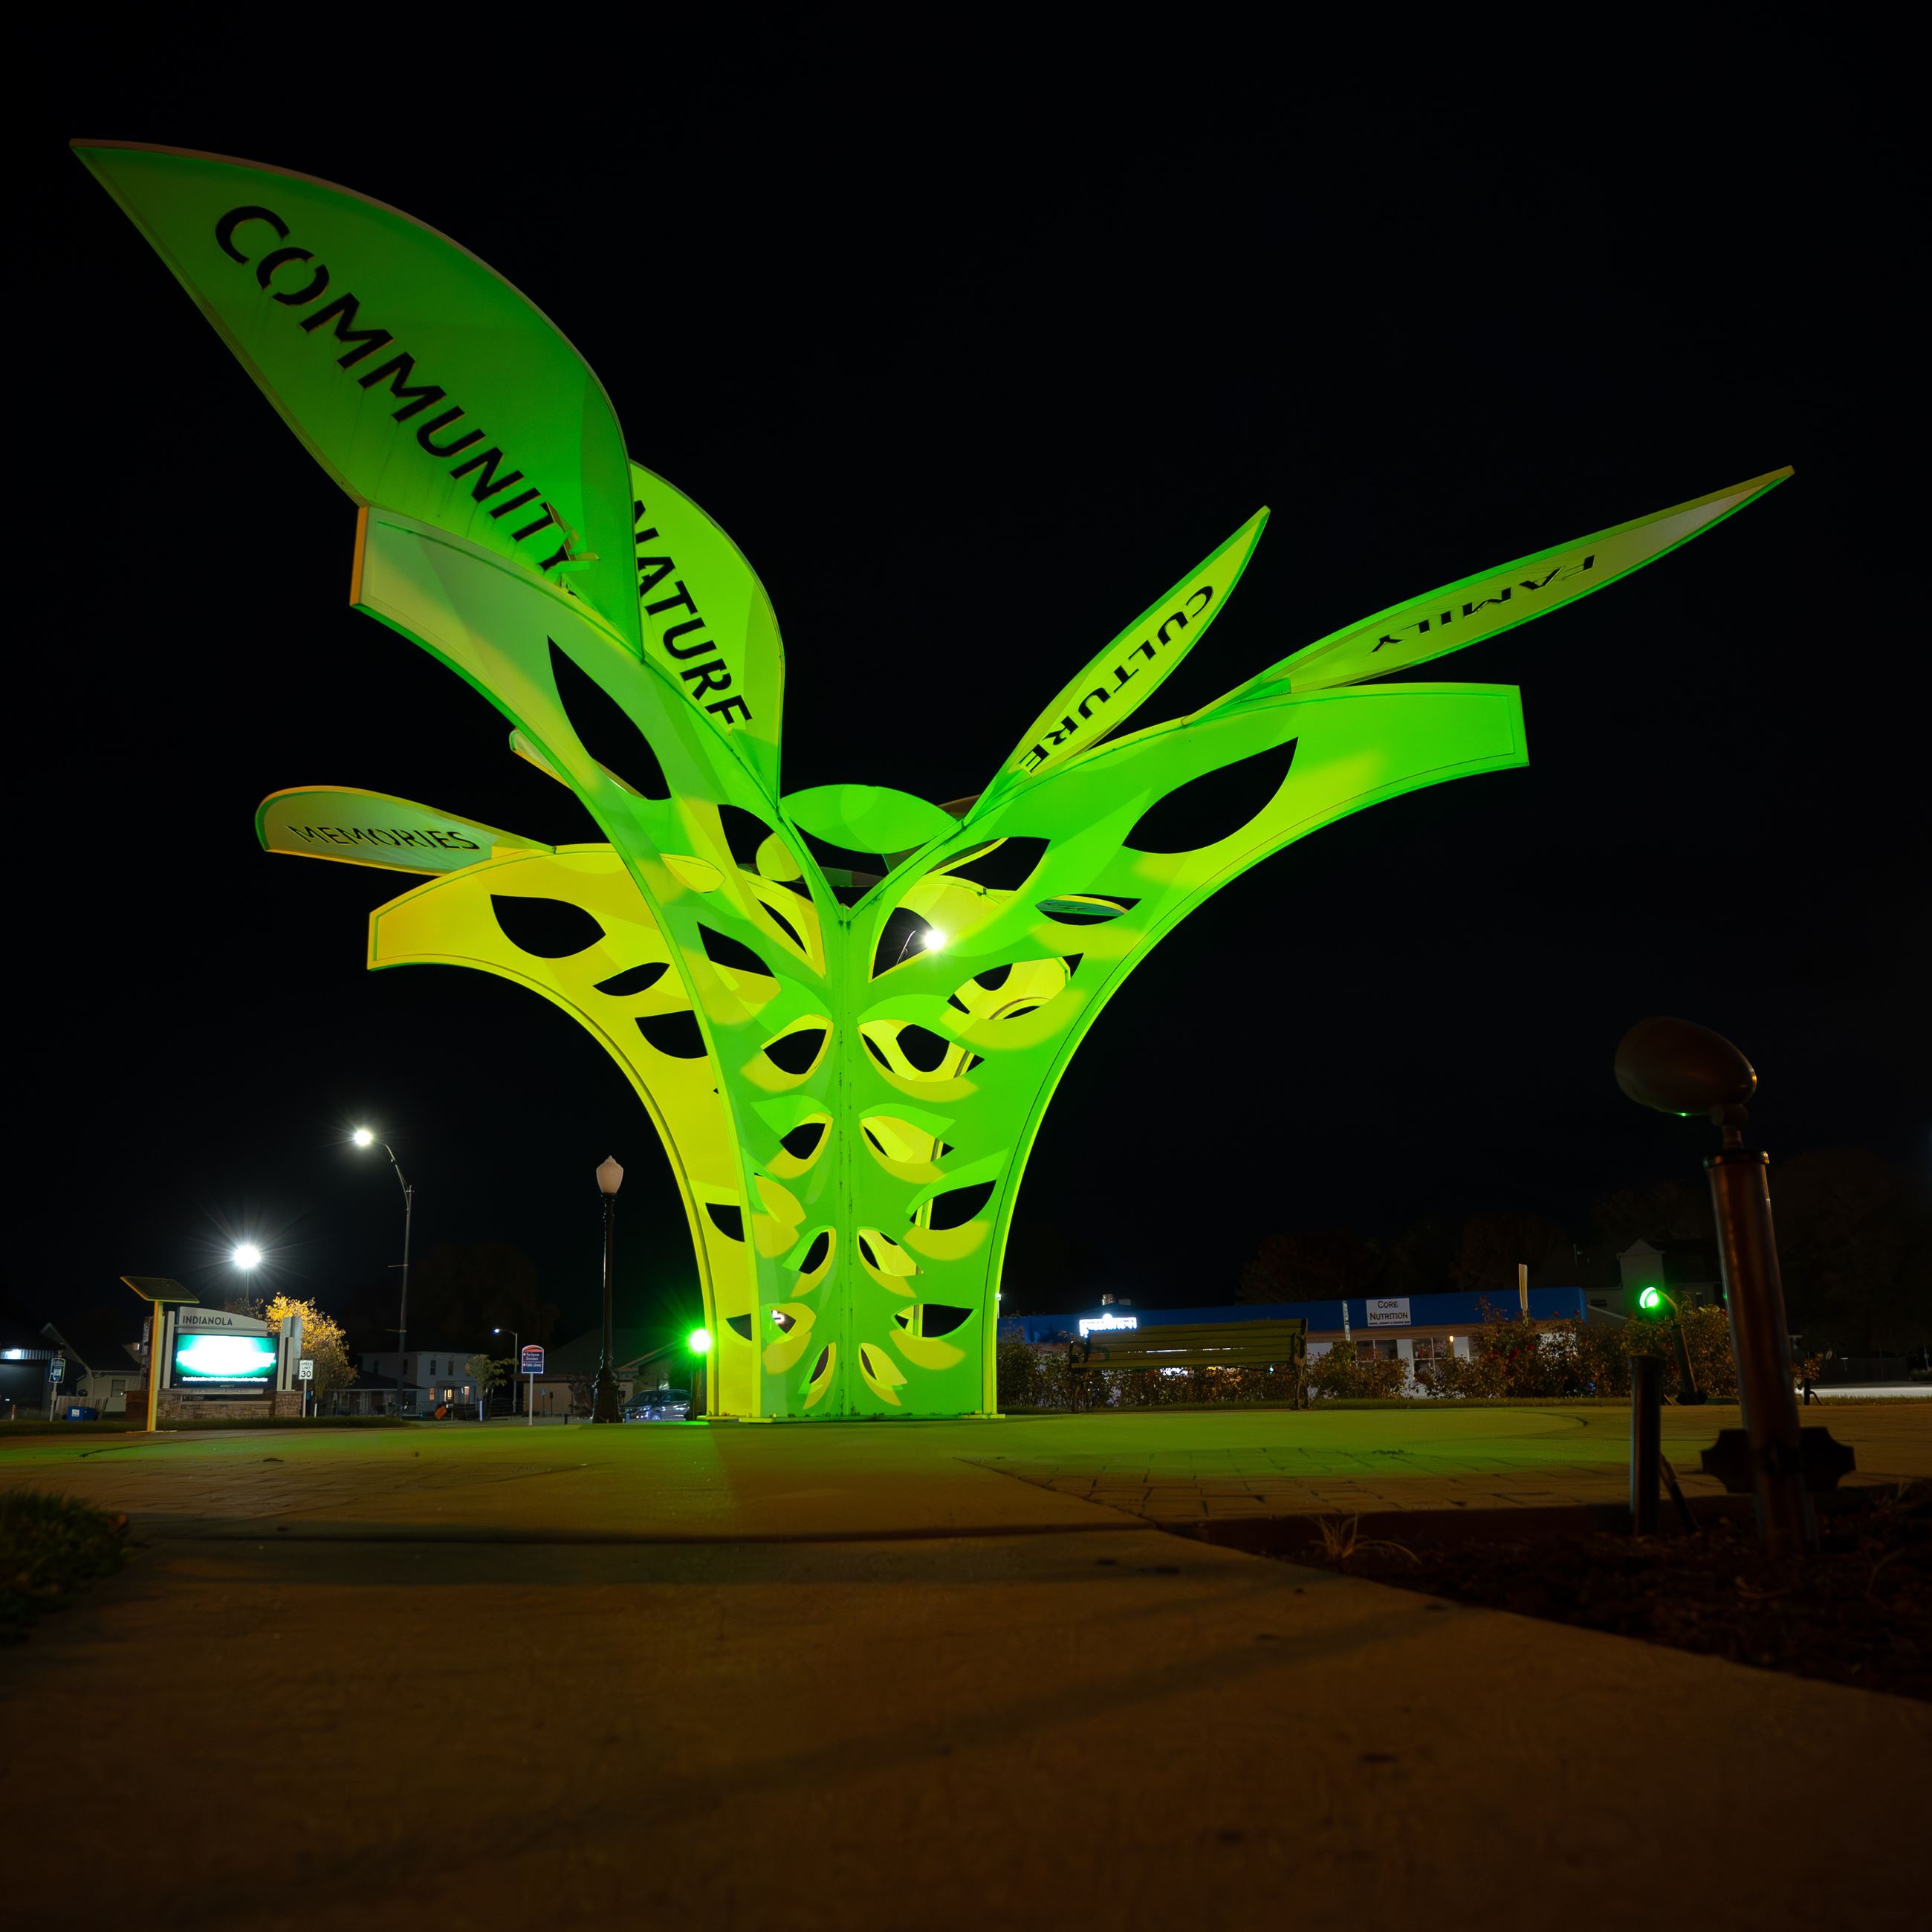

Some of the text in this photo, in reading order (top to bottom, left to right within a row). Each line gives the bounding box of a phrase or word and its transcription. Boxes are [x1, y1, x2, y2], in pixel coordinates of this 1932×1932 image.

[215, 206, 600, 571] COMMUNITY
[1370, 554, 1595, 654] FAMILY
[1019, 586, 1213, 773] CULTURE
[286, 826, 480, 850] MEMORIES
[182, 1315, 233, 1326] INDIANOLA
